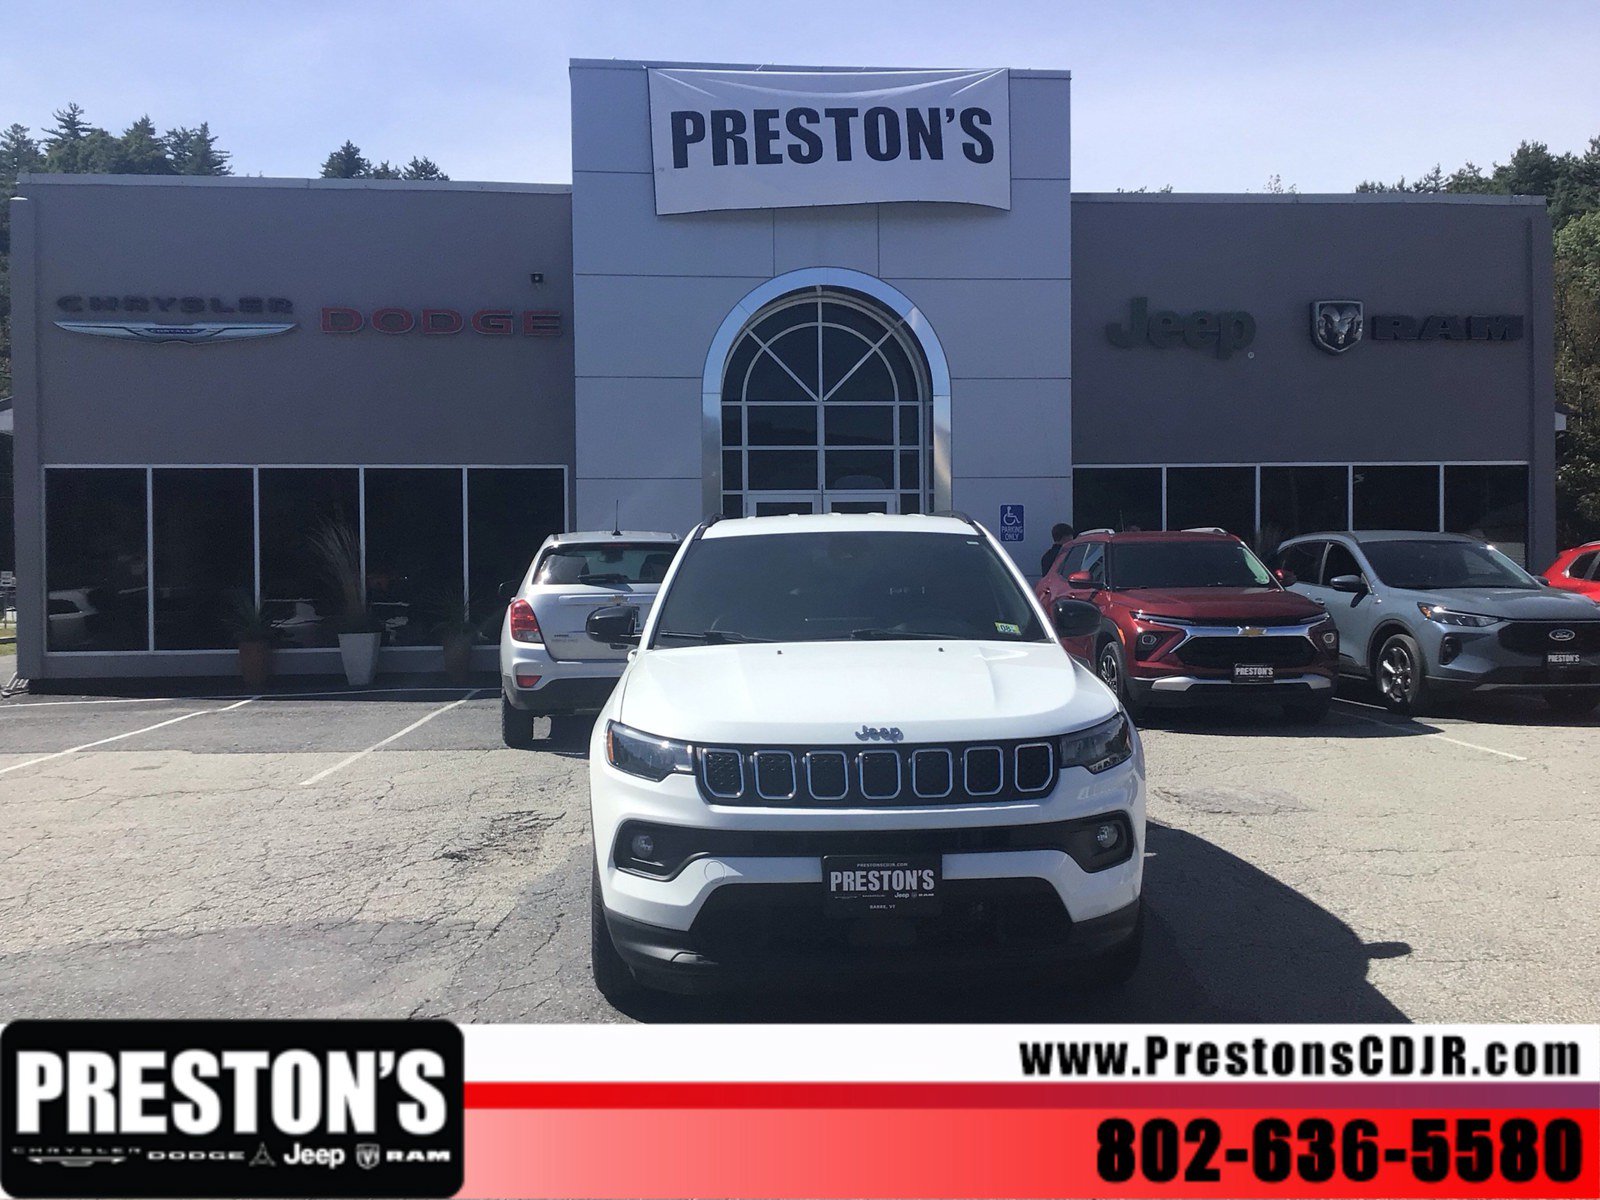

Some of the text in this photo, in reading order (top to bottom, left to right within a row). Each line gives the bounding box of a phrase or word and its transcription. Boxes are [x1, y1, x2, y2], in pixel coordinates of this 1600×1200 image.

[671, 106, 995, 169] PRESTON'S
[57, 295, 293, 314] CHRYSLER
[320, 307, 562, 336] DODGE
[1106, 297, 1256, 358] Jeep
[1371, 315, 1523, 340] RAM
[1235, 667, 1274, 676] PRESTON'S
[855, 725, 904, 742] Jeep
[830, 869, 935, 891] PRESTON'S
